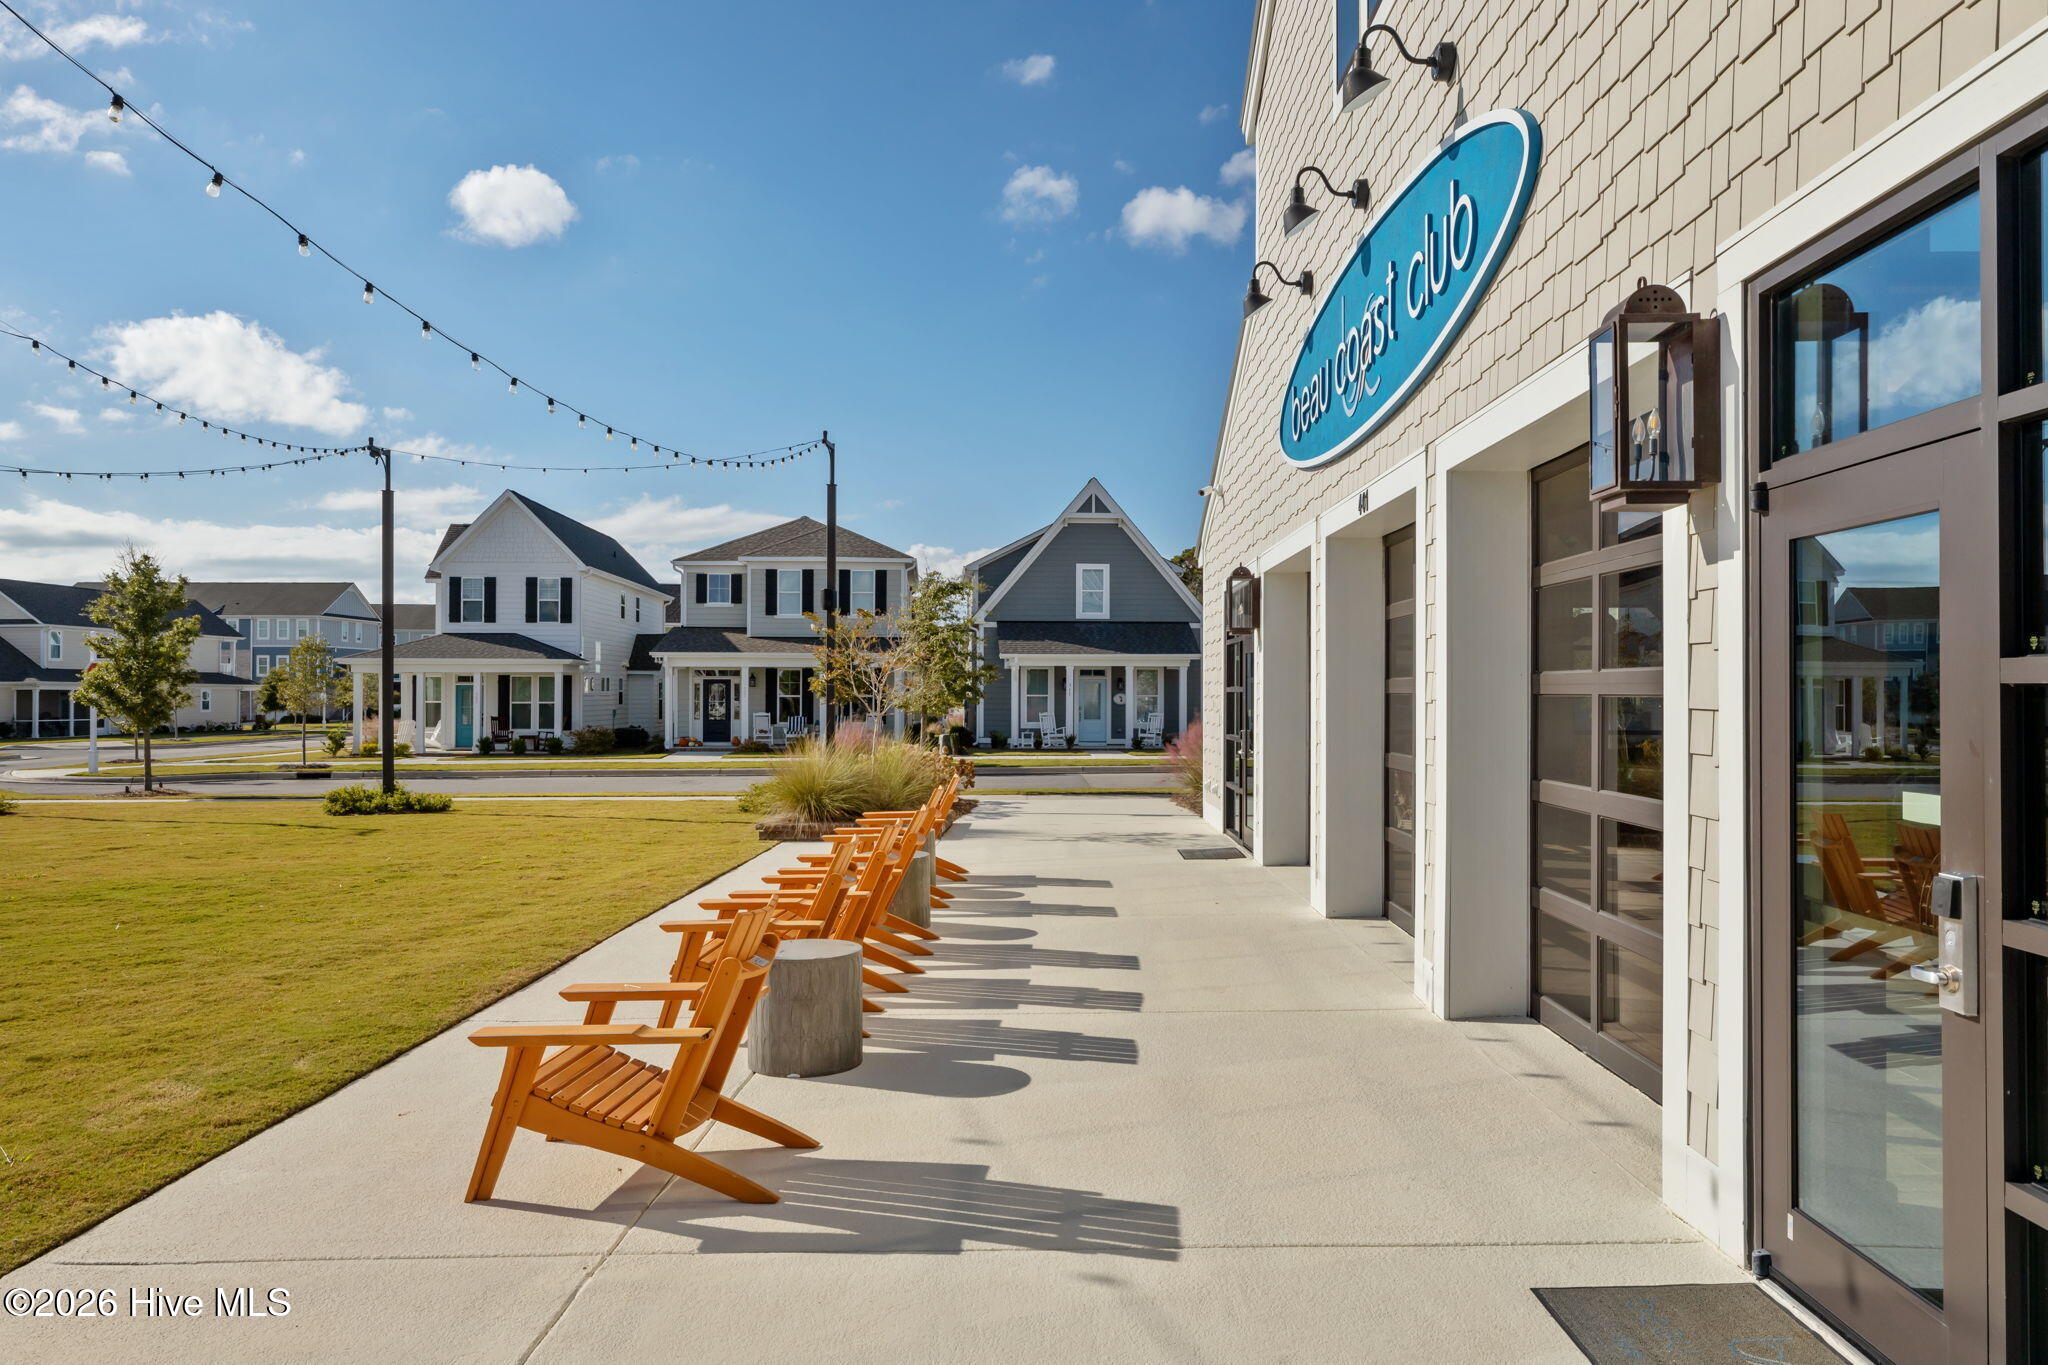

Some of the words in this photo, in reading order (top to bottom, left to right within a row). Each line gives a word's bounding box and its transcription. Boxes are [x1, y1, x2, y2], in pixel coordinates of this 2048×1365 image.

[1291, 360, 1330, 441] beau
[1335, 261, 1395, 395] coast
[1407, 180, 1474, 318] club
